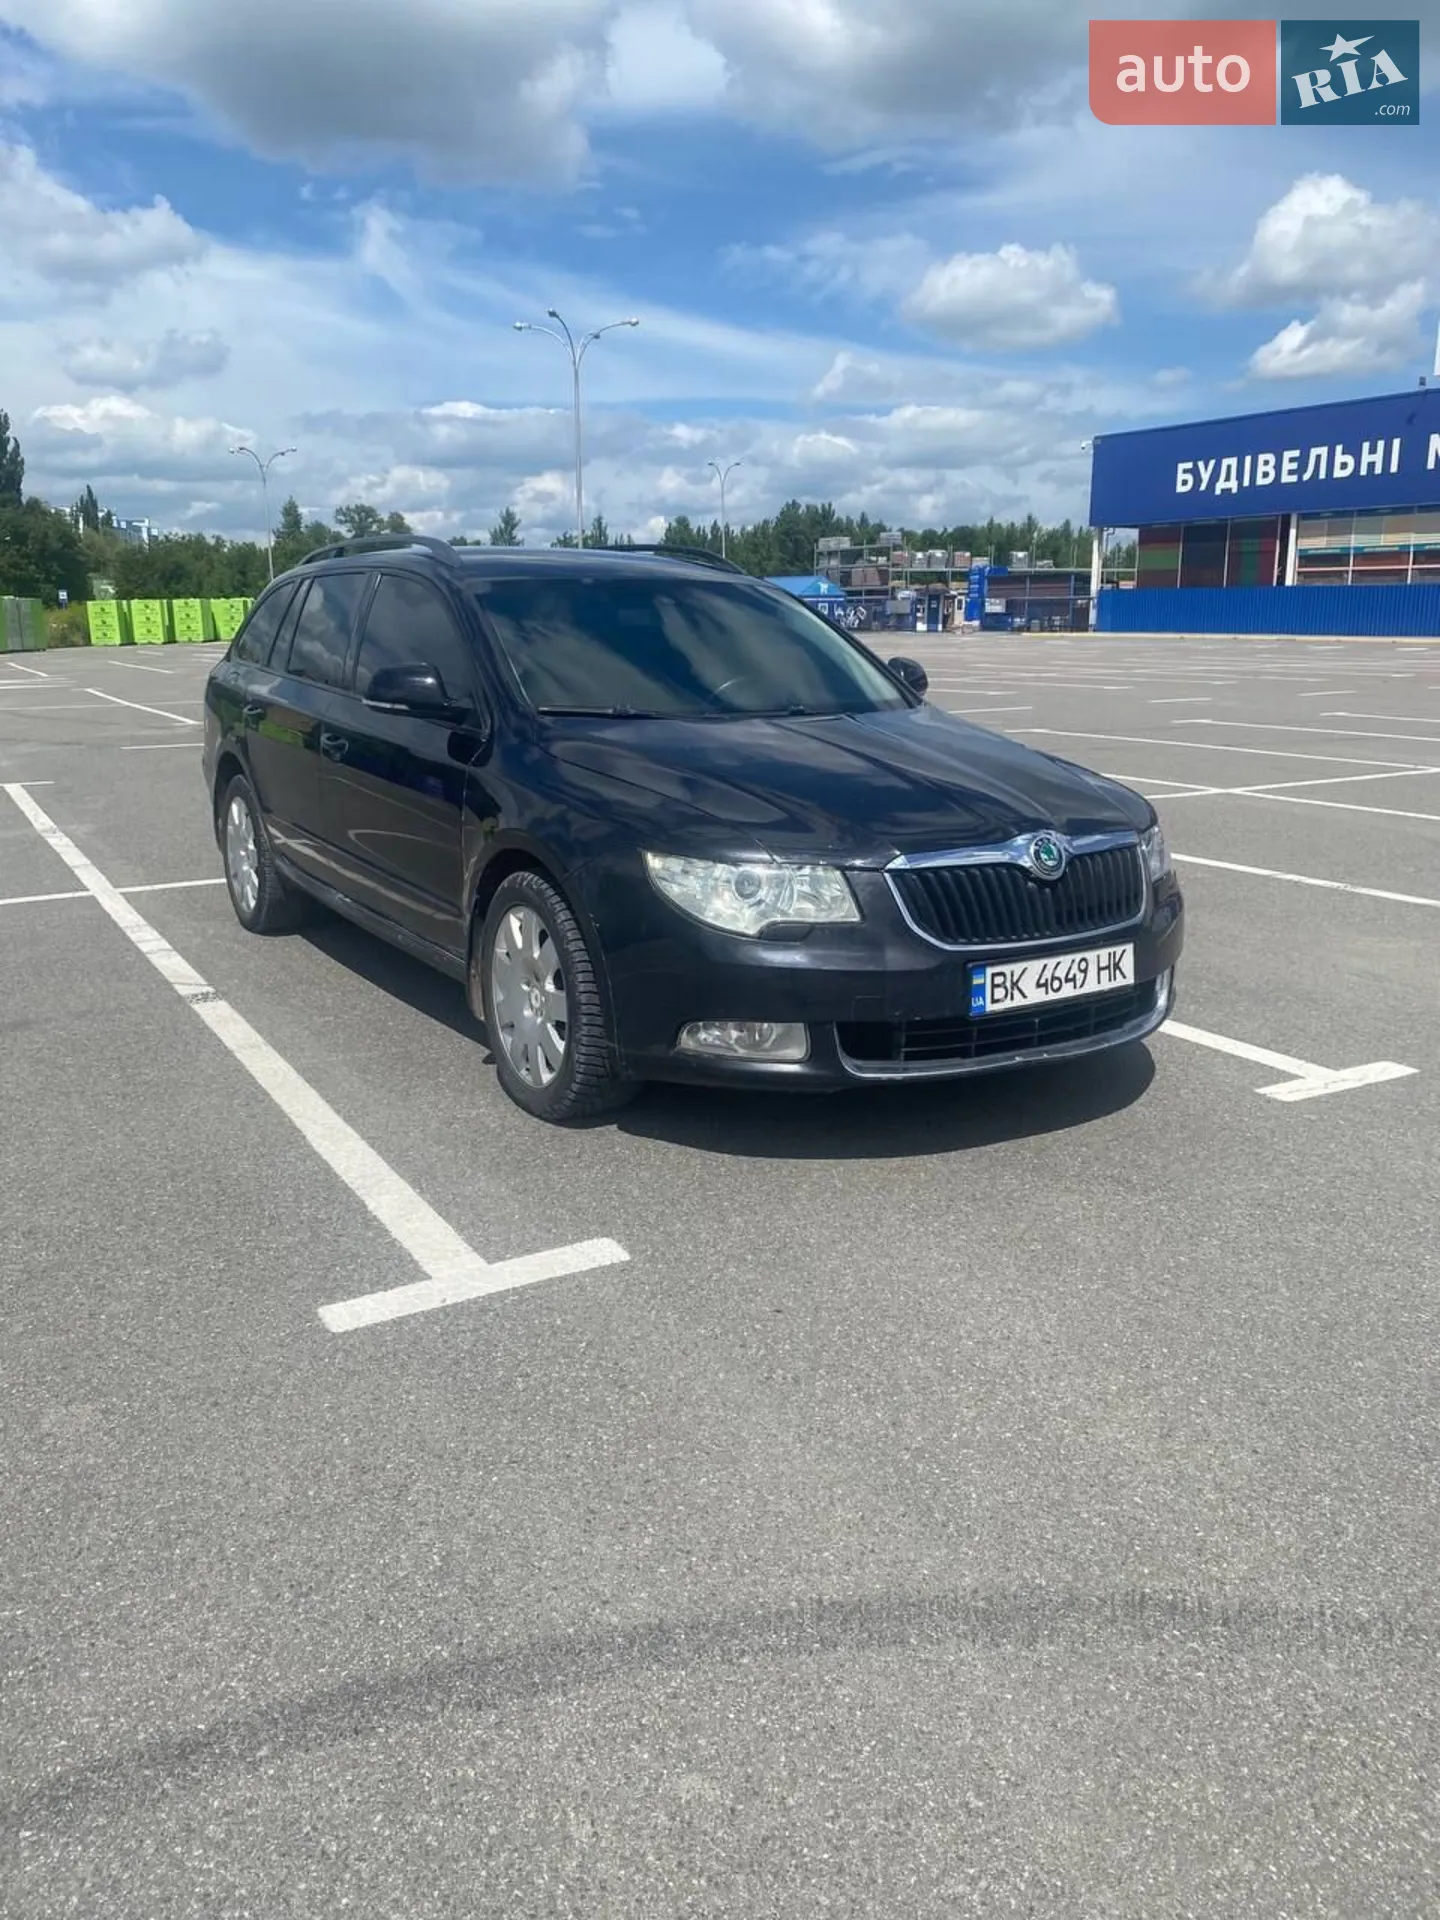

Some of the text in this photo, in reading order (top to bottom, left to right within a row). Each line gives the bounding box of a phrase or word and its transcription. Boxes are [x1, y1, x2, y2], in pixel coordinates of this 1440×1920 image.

[1175, 437, 1401, 496] БУДІВЕЛЬНІ
[971, 995, 985, 1008] UA
[990, 949, 1127, 1005] BK 4649 HK
